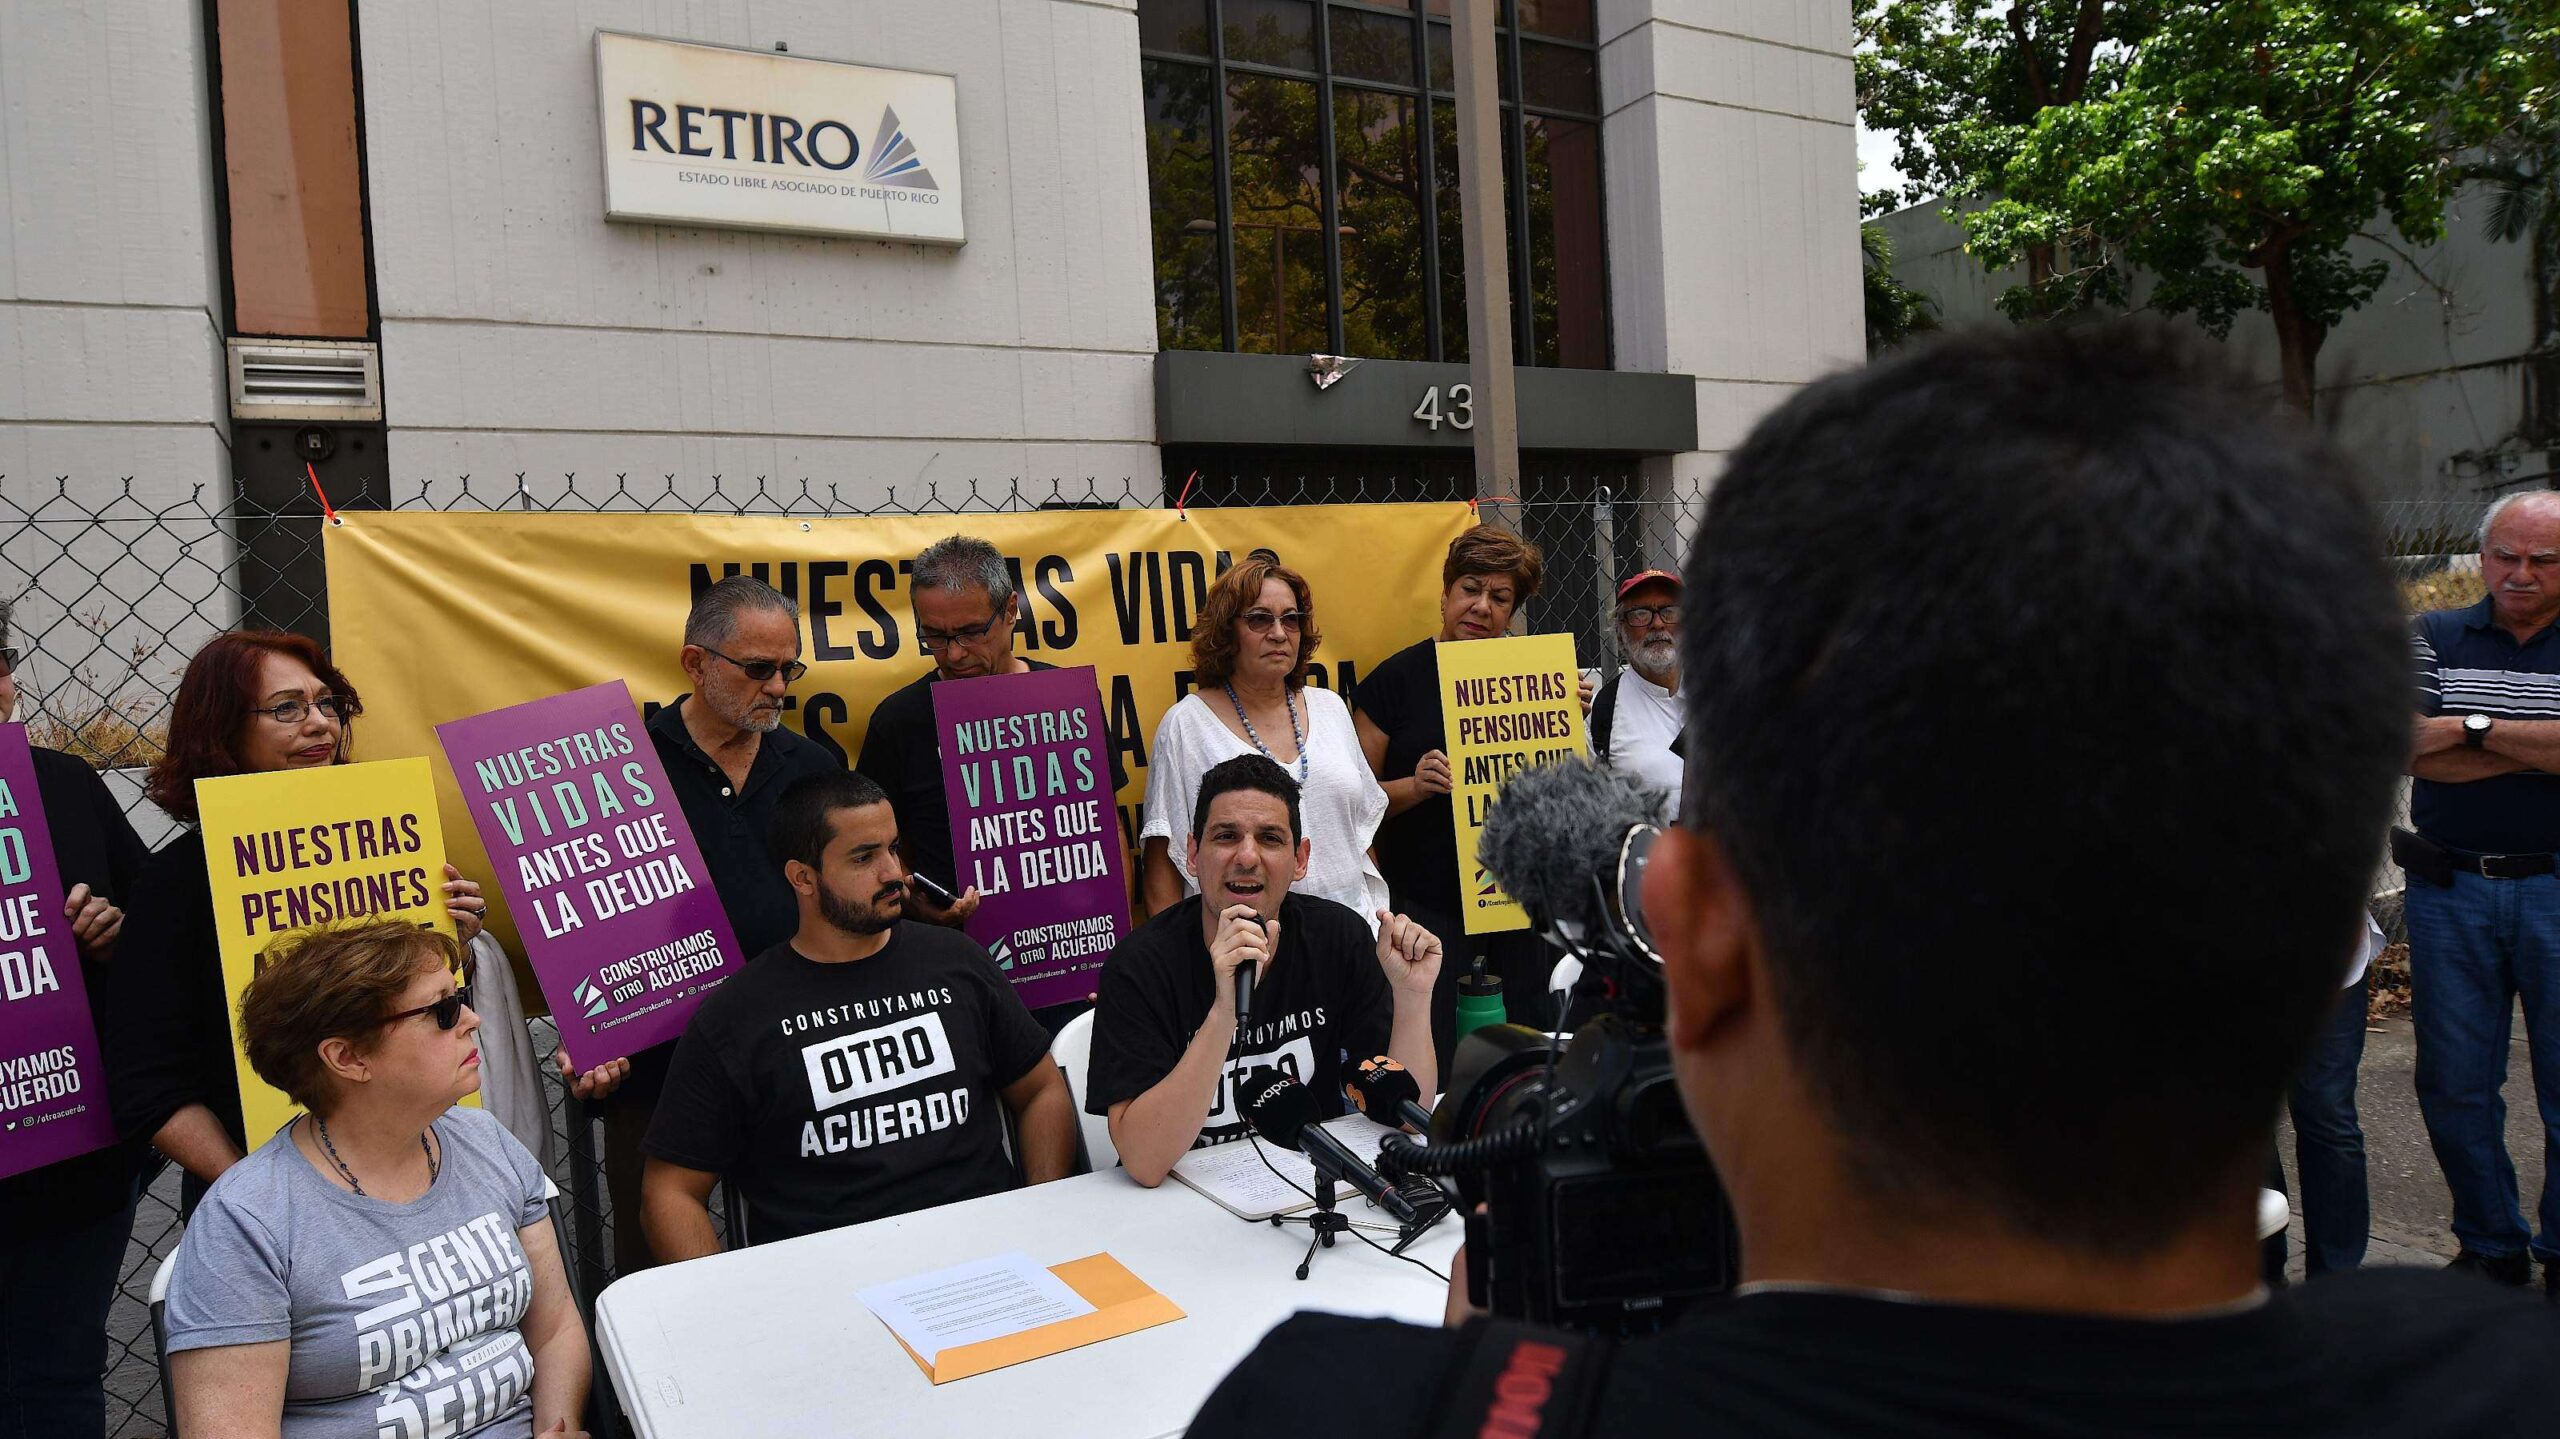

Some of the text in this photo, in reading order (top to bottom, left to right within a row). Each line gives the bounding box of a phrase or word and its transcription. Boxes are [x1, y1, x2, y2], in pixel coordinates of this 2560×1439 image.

[629, 99, 859, 170] RETIRO
[679, 171, 939, 205] ESTADO LIBRE ASOCIADO DE PUERTO RICO
[1413, 383, 1474, 430] 43
[1105, 549, 1280, 645] VID
[1455, 671, 1567, 708] NUESTRAS
[955, 707, 1089, 755] NUESTRAS
[1459, 709, 1571, 746] PENSIONES
[474, 722, 635, 794] NUESTRAS
[960, 747, 1095, 809] VIDAS
[1464, 748, 1573, 786] ANTES QU
[490, 761, 656, 847] VIDAS
[970, 808, 1045, 852] ANTES
[1054, 800, 1102, 838] QUE
[232, 813, 422, 877] NUESTRAS
[516, 812, 677, 893] ANTES QUE
[973, 856, 1010, 897] LA
[1020, 840, 1109, 890] DEUDA
[241, 867, 430, 936] PENSIONES
[533, 853, 696, 940] LA DEUDA
[599, 929, 717, 987] CONSTRUYAMOS
[1013, 914, 1114, 948] CONSTRUYAMOS
[1020, 932, 1116, 965] OTRO ACUERDO
[613, 947, 725, 1003] OTRO ACUERDO
[781, 987, 952, 1036] CONSTRUYAMOS
[820, 1025, 935, 1094] OTRO
[801, 1087, 969, 1158] ACUERDO
[1252, 1080, 1291, 1107] wapa
[408, 1211, 523, 1303] GENTE
[357, 1267, 532, 1392] PRIMERO
